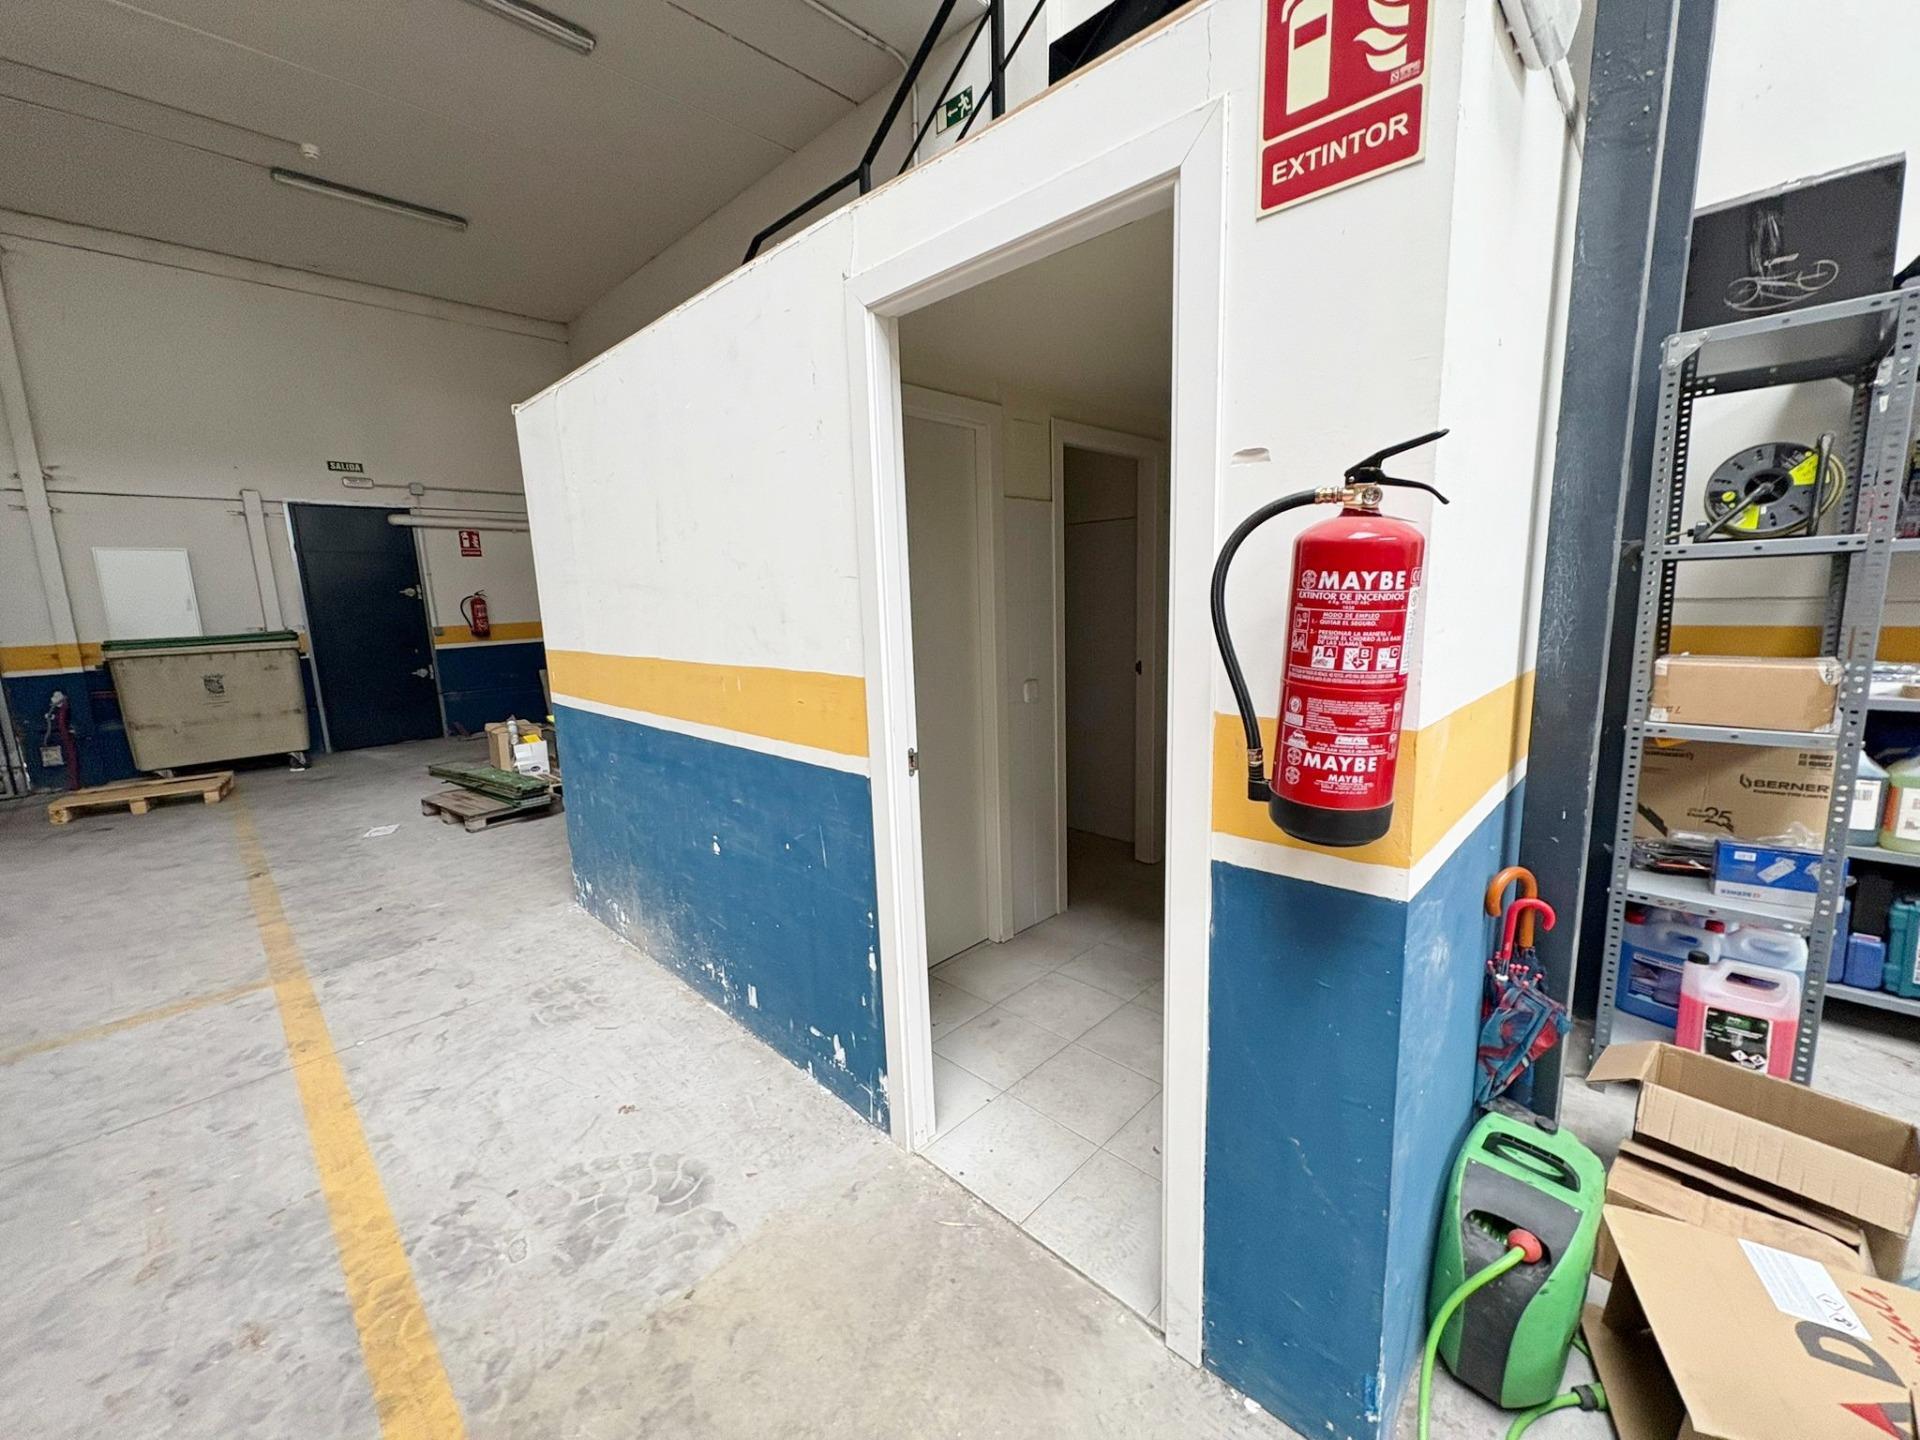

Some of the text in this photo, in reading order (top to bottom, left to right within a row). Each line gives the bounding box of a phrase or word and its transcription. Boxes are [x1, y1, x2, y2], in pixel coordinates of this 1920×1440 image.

[1272, 112, 1409, 186] EXTINTOR
[330, 462, 361, 472] SALIDA
[1318, 570, 1407, 591] MAYBE
[1299, 591, 1405, 602] EXTINTOR DE INCENDIOS
[1325, 648, 1399, 657] A B C
[1303, 752, 1377, 772] MAYBE
[1328, 774, 1364, 783] MAYBE
[1753, 780, 1831, 793] BERNER
